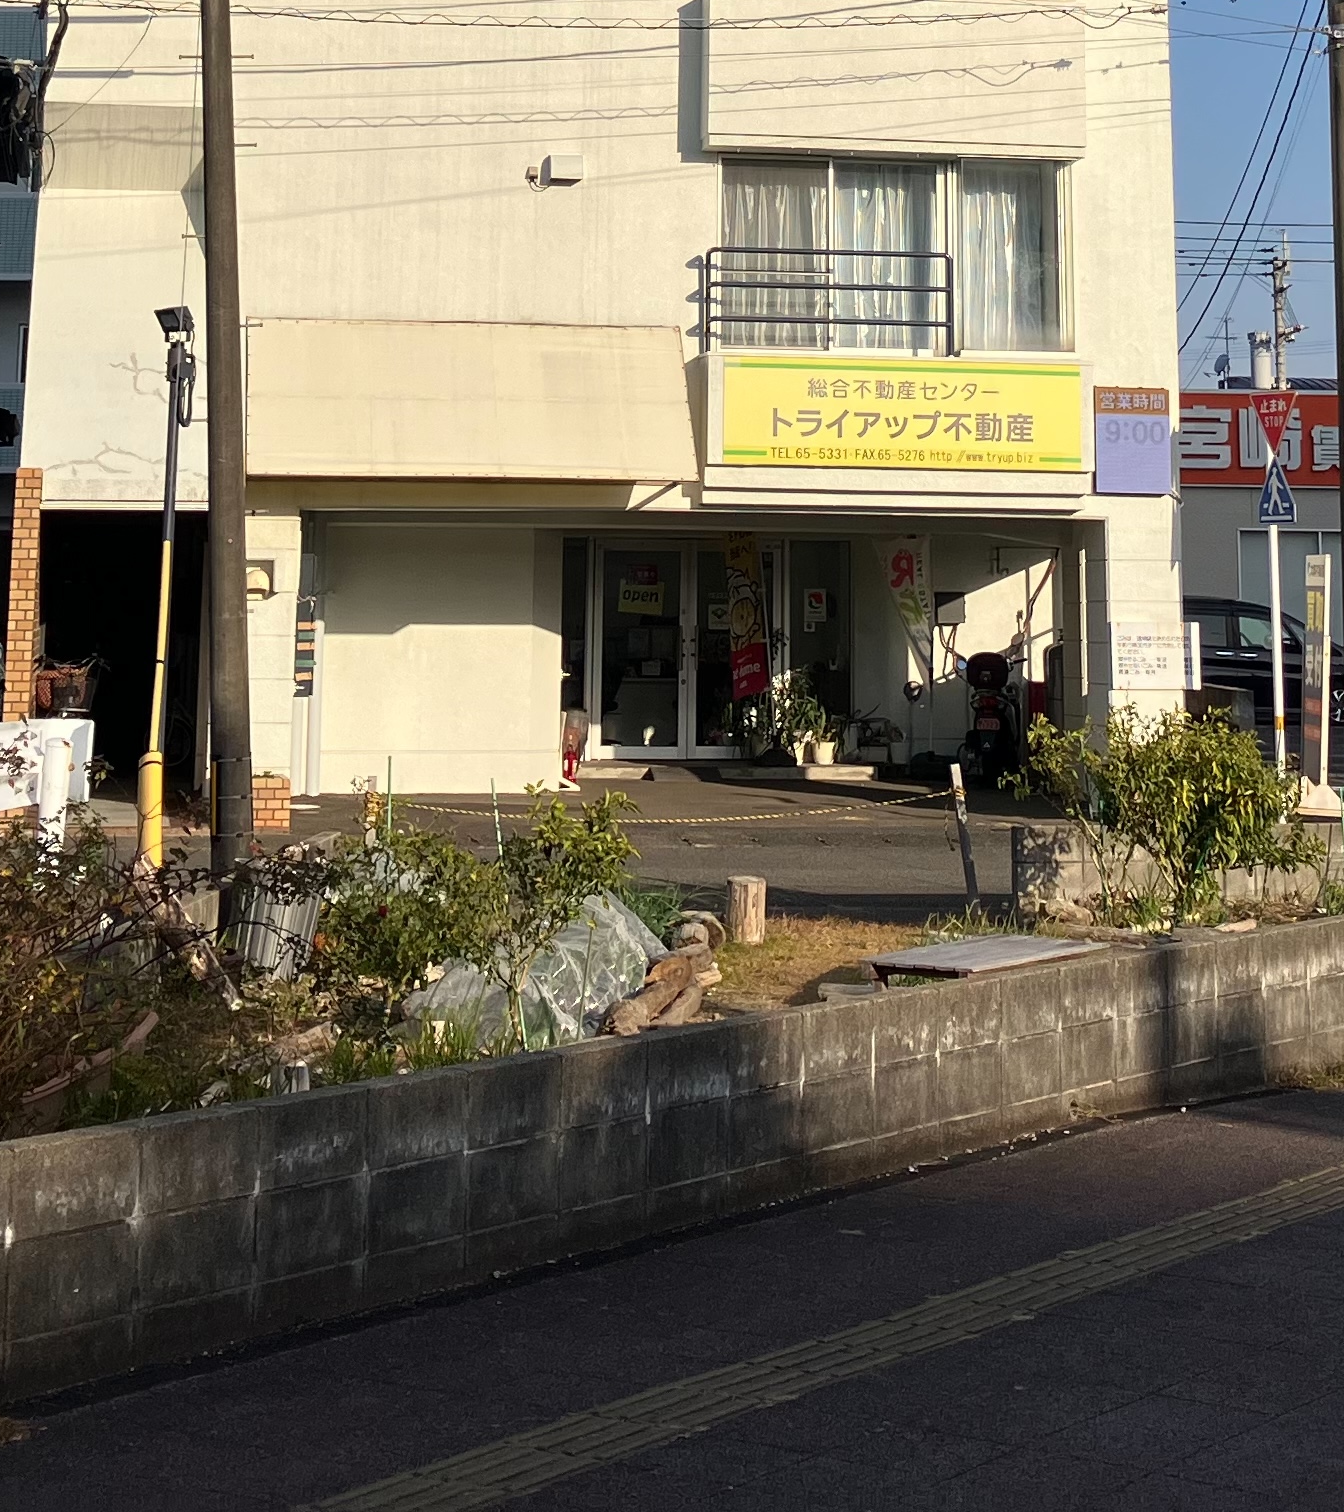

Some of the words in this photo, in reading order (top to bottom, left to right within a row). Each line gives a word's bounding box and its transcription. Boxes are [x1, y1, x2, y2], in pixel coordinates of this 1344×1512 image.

[807, 377, 1000, 402] 総合不動産センター
[1100, 392, 1166, 411] 営業時間
[1259, 398, 1287, 413] 止まれ
[770, 408, 1034, 444] トライアップ不動産
[1264, 415, 1284, 428] STOP
[1105, 419, 1165, 445] 9:00
[622, 589, 659, 603] open
